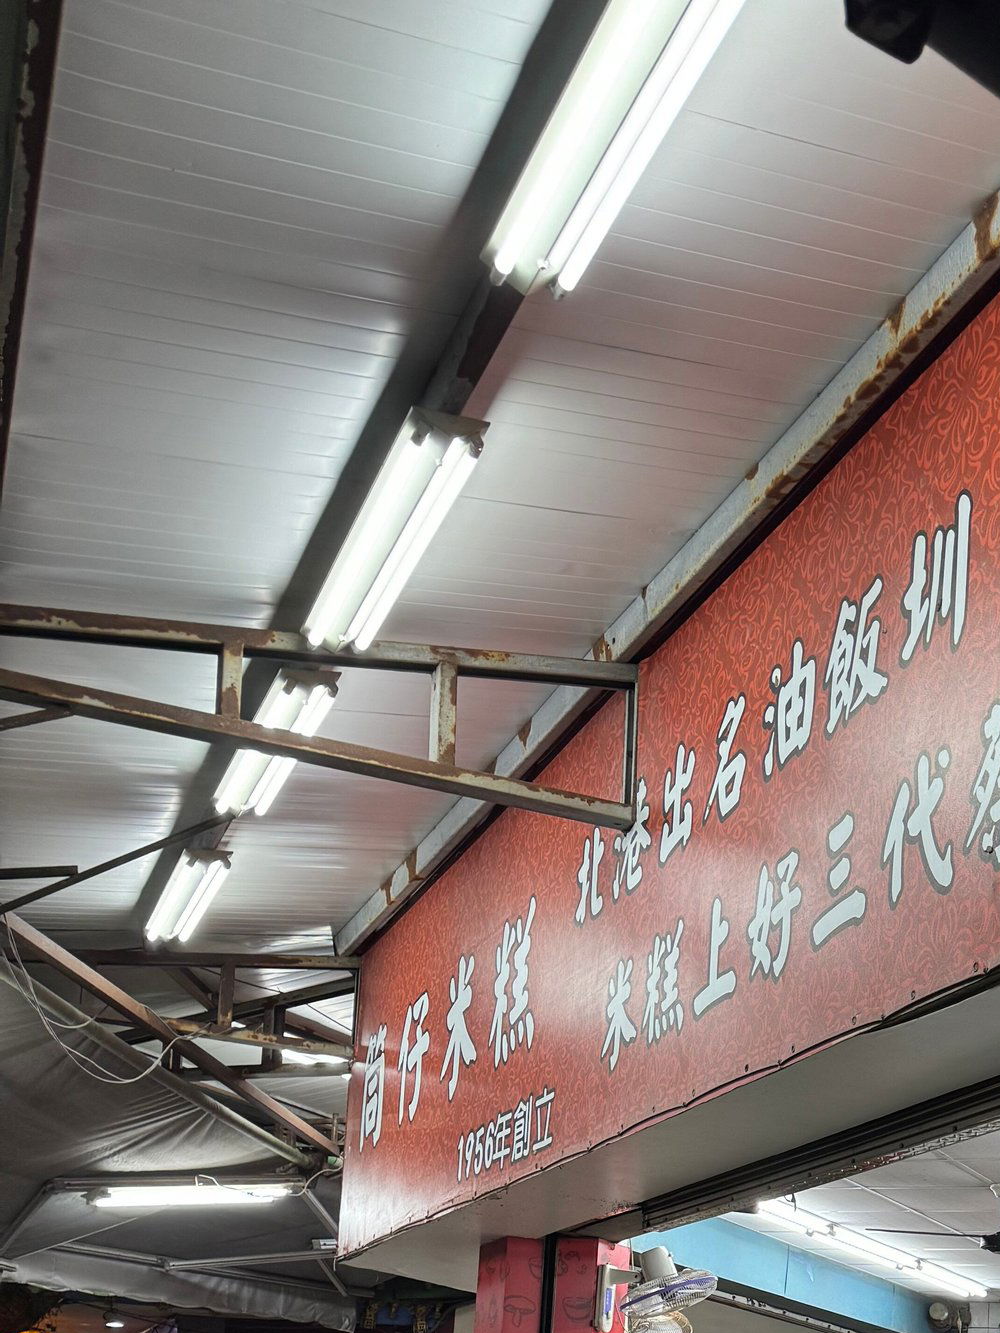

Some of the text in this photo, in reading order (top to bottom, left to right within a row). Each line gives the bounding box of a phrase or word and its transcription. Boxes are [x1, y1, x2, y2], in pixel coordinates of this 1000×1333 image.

[359, 896, 537, 1153] 筒仔米糕
[457, 1086, 557, 1183] 1956年創立
